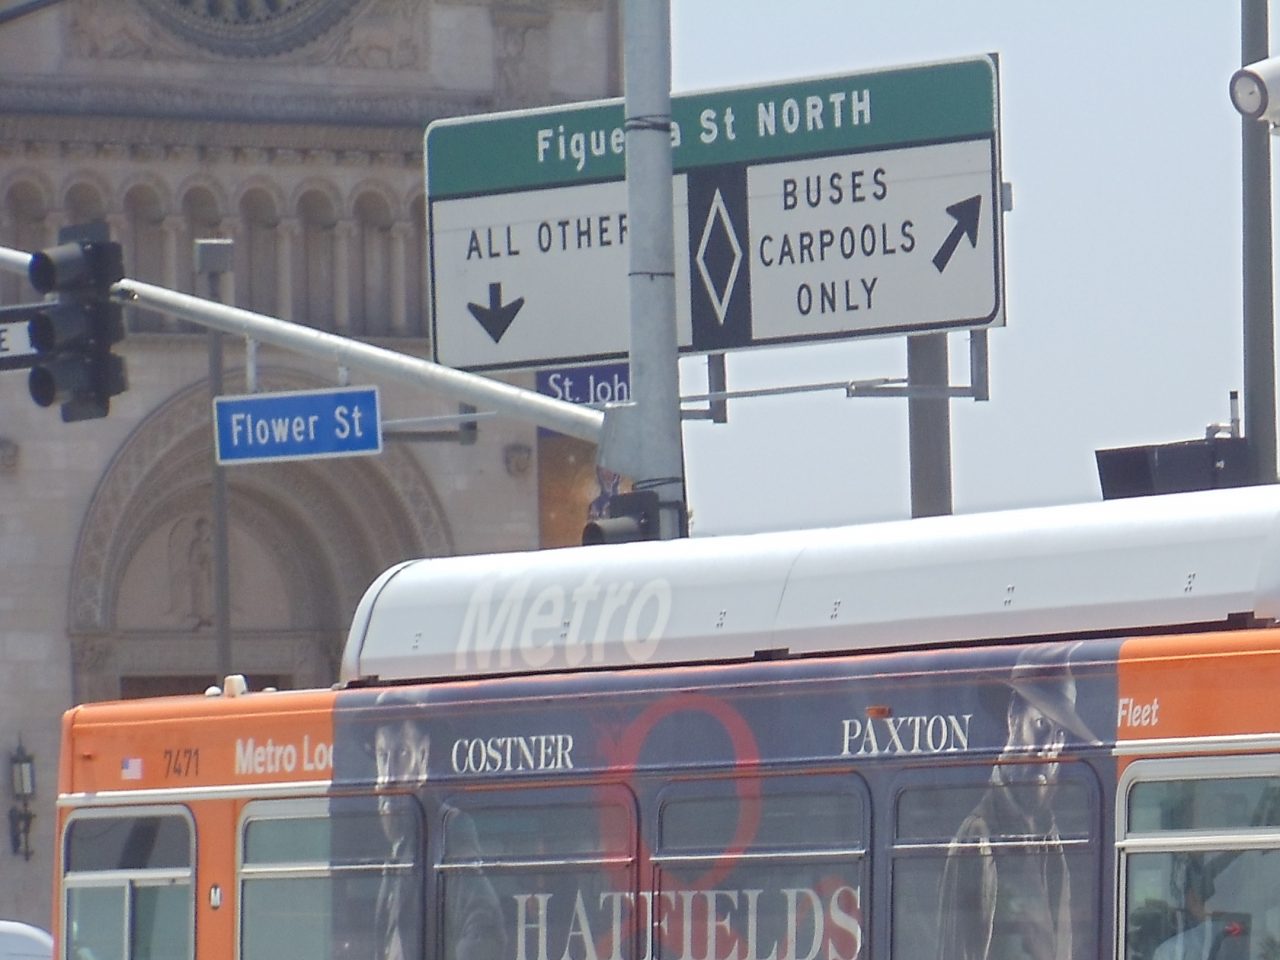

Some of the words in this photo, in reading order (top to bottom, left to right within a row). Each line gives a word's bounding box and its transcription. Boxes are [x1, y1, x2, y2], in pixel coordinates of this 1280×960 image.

[537, 121, 681, 171] Figuea
[700, 106, 735, 144] St
[757, 89, 872, 137] NORTH
[783, 167, 888, 210] BUSES
[467, 222, 520, 260] ALL
[759, 220, 916, 268] CARPOOLS
[797, 277, 879, 316] ONLY
[588, 374, 628, 404] Joh
[231, 410, 318, 447] Flower
[335, 406, 364, 438] St
[456, 569, 672, 670] Metro
[1117, 698, 1159, 728] Fleet
[452, 734, 574, 773] COSTNER
[841, 714, 973, 757] PAXTON
[163, 748, 200, 778] 7471
[235, 738, 297, 775] Metro
